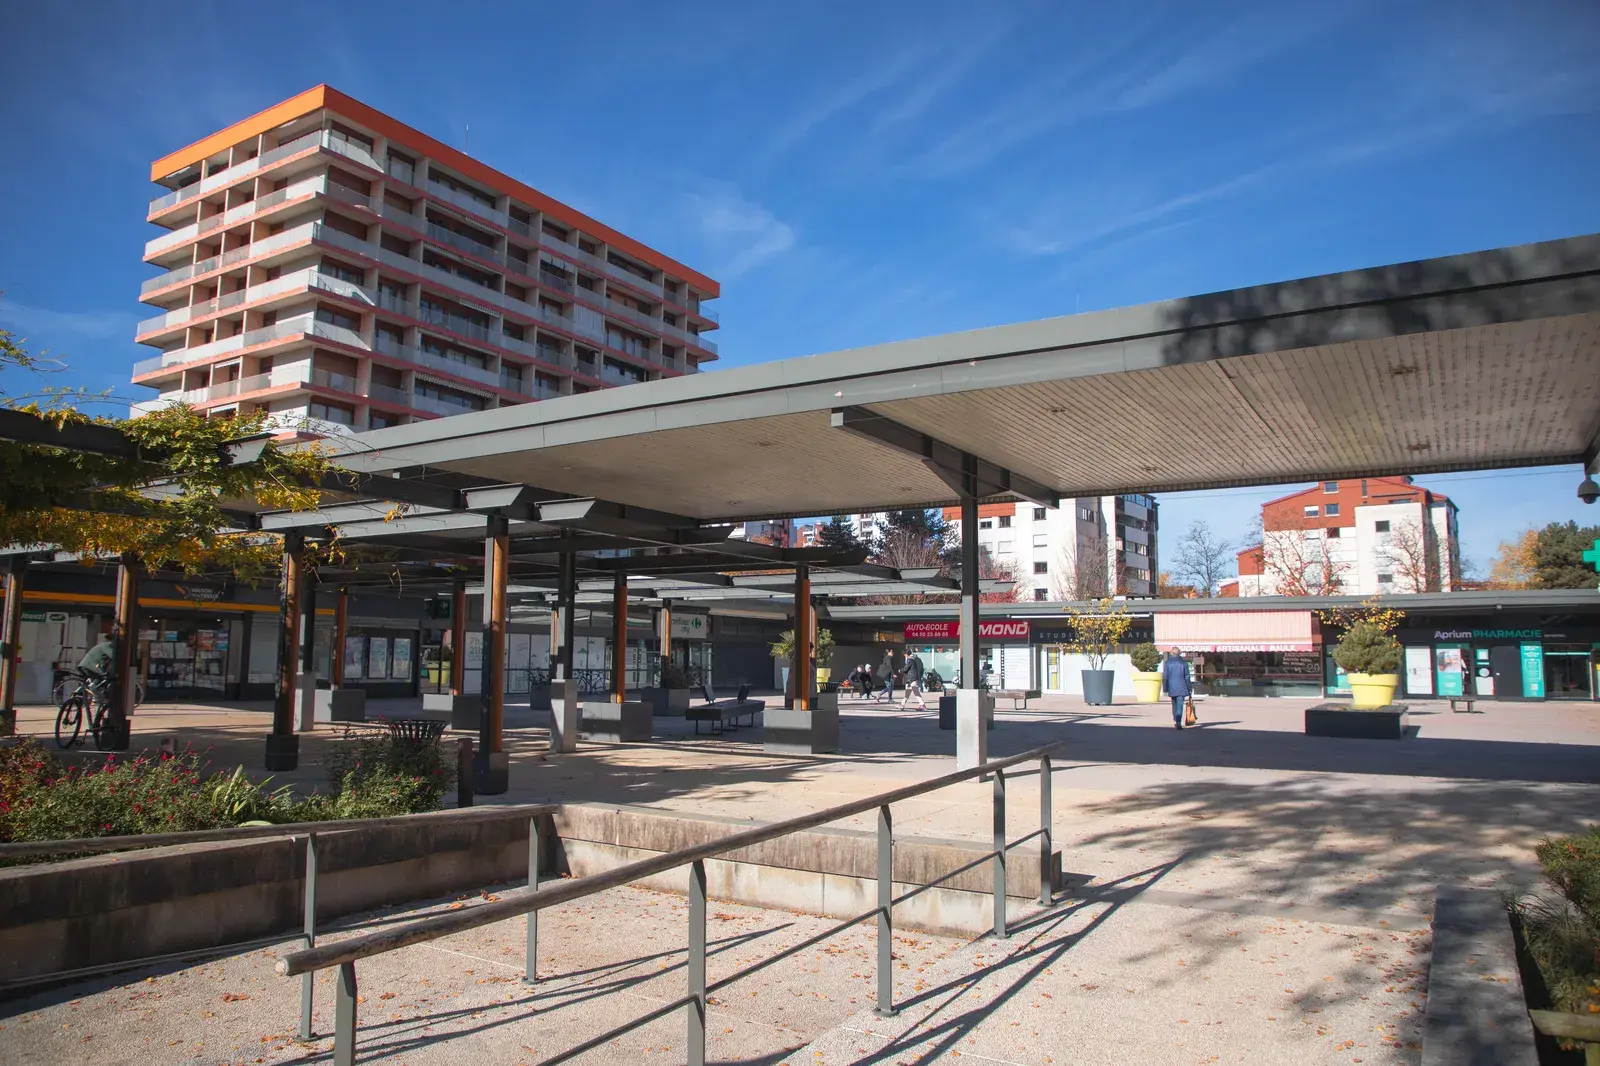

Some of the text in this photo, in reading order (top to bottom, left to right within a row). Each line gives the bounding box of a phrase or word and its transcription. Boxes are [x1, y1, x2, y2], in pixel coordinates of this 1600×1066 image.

[906, 623, 949, 631] AUTO-ECOLE
[957, 624, 1028, 635] MOND
[1434, 629, 1473, 639] Aprium
[1473, 629, 1542, 638] PHARMACIE
